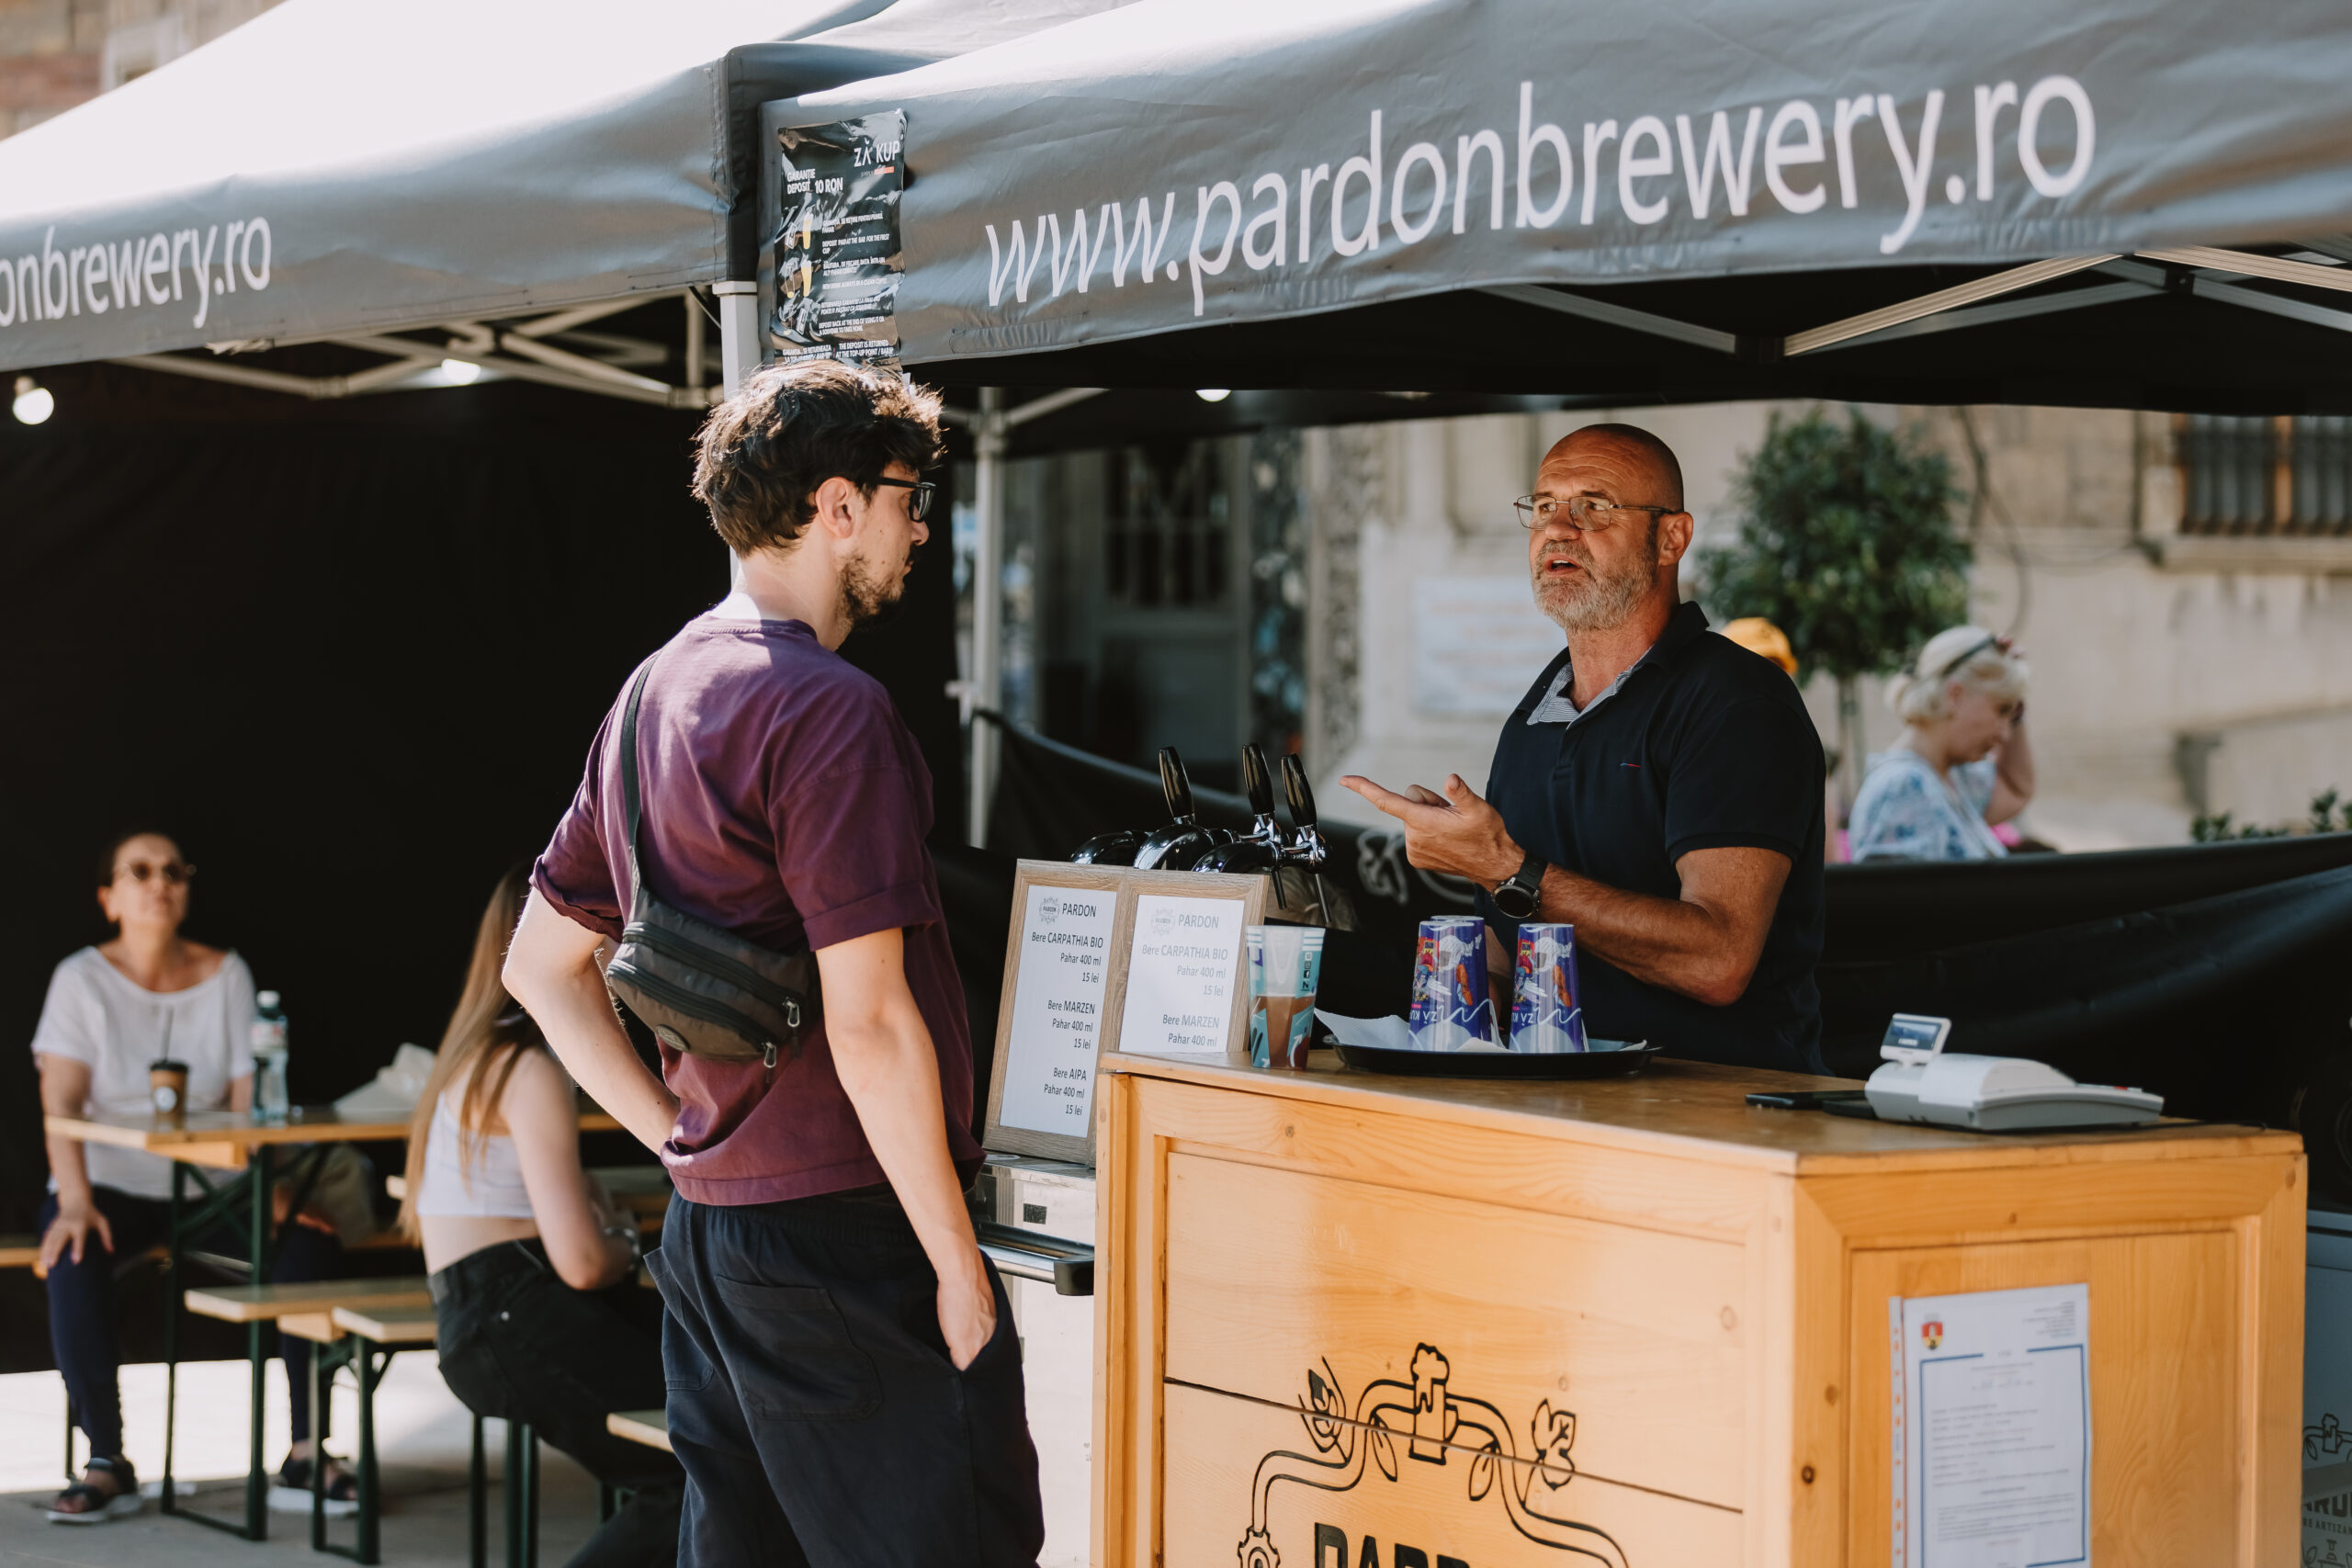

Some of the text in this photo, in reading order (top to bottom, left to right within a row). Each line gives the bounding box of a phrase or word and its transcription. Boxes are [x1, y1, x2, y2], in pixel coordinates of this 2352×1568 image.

[876, 140, 899, 164] KUP
[787, 177, 843, 194] DEPOSIT 10 RON
[985, 74, 2096, 317] www.pardonbrewery.ro
[847, 341, 863, 349] DEPOSIT
[1062, 903, 1097, 917] PARDON
[1178, 914, 1219, 928] PARDON
[1031, 932, 1103, 948] Bere CARPATHIA BIO
[1061, 953, 1101, 966] Pahar 400 ml
[1142, 944, 1228, 961] Bere CARPATHIA BIO
[1082, 972, 1099, 983] 15 lei
[1176, 965, 1226, 978] Pahar 400 ml
[1203, 985, 1223, 996] 15 lei
[1048, 1000, 1095, 1015] Bere MARZEN
[1052, 1018, 1093, 1032] Pahar 400 ml
[1163, 1014, 1219, 1029] Bere MARZEN
[1073, 1038, 1091, 1049] 15 lei
[1168, 1033, 1217, 1047] Pahar 400 ml
[1053, 1067, 1087, 1081] Bere AIPA
[1044, 1083, 1085, 1099] Pahar 400 ml
[1065, 1104, 1082, 1116] 15 lei
